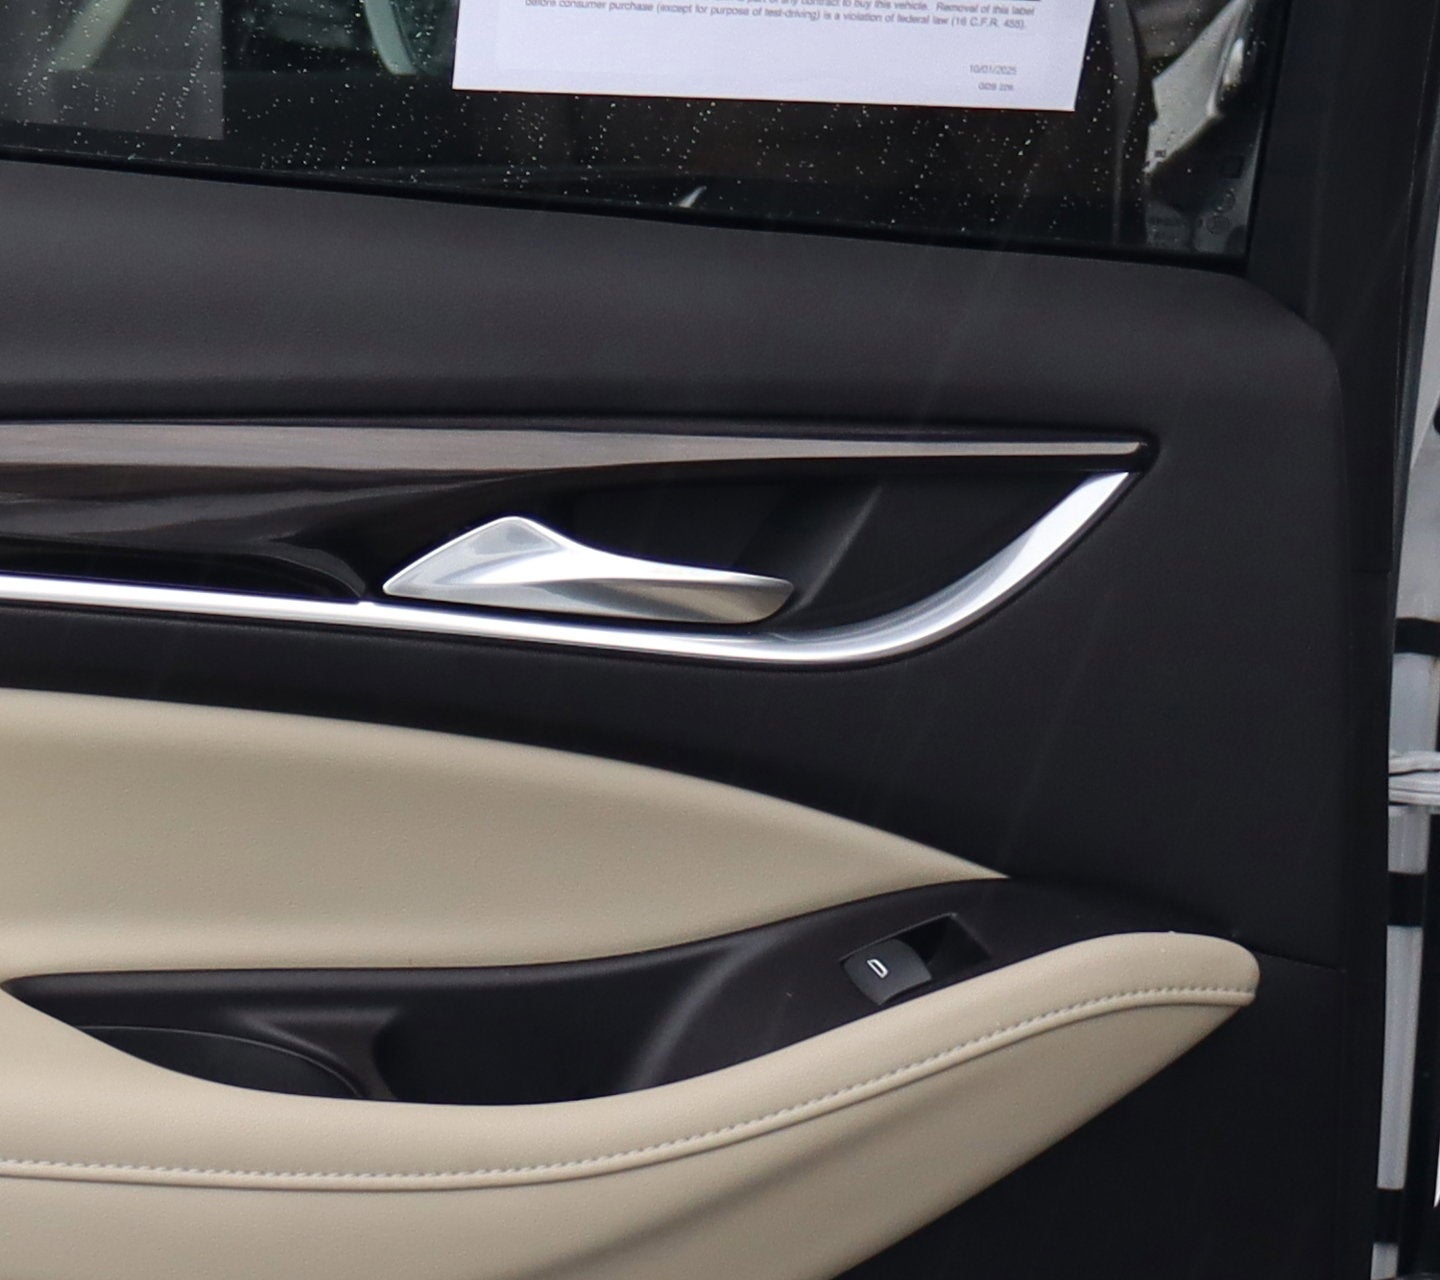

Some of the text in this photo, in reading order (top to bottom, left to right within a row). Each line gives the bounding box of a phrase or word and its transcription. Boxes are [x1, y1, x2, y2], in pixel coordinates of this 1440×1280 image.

[559, 0, 606, 9] consumer
[609, 1, 654, 12] purchase
[656, 3, 693, 15] (except
[695, 4, 708, 14] for
[710, 7, 750, 16] purpose
[752, 7, 763, 17] of
[764, 8, 821, 22] test-driving)
[823, 10, 832, 20] is
[834, 12, 841, 21] a
[843, 12, 883, 22] violation
[884, 13, 895, 23] of
[897, 14, 930, 24] federal
[932, 16, 949, 25] law
[874, 0, 892, 10] this
[894, 1, 928, 11] vehicle.
[936, 2, 979, 13] Removal
[980, 4, 991, 14] of
[992, 5, 1009, 15] this
[1012, 6, 1035, 16] label
